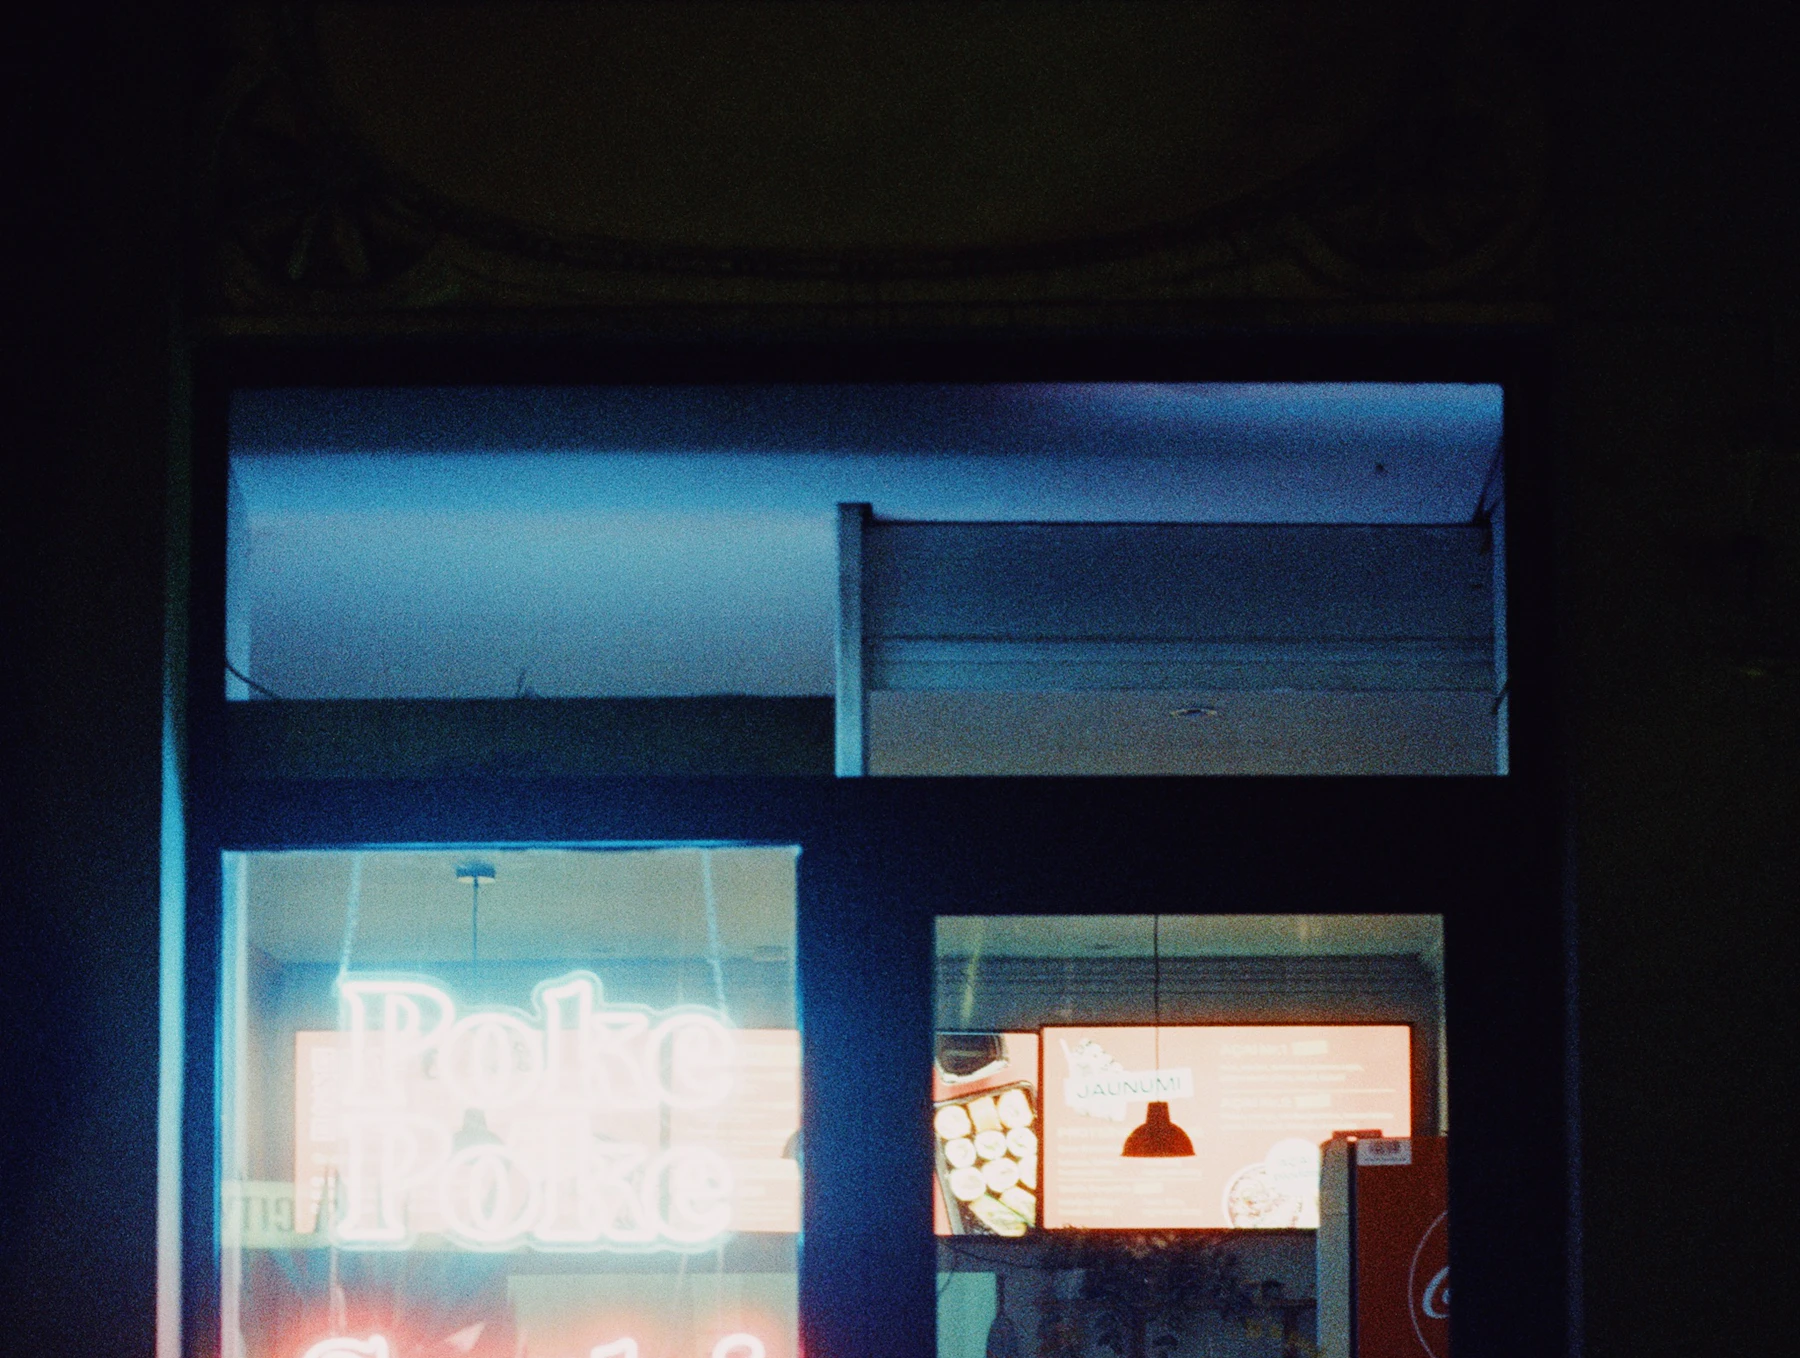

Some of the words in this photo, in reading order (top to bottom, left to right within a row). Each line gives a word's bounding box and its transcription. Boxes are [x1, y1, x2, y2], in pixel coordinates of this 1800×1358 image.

[334, 970, 736, 1112] Poke
[1076, 1076, 1181, 1098] JAUNUMI
[334, 1124, 736, 1252] Poke
